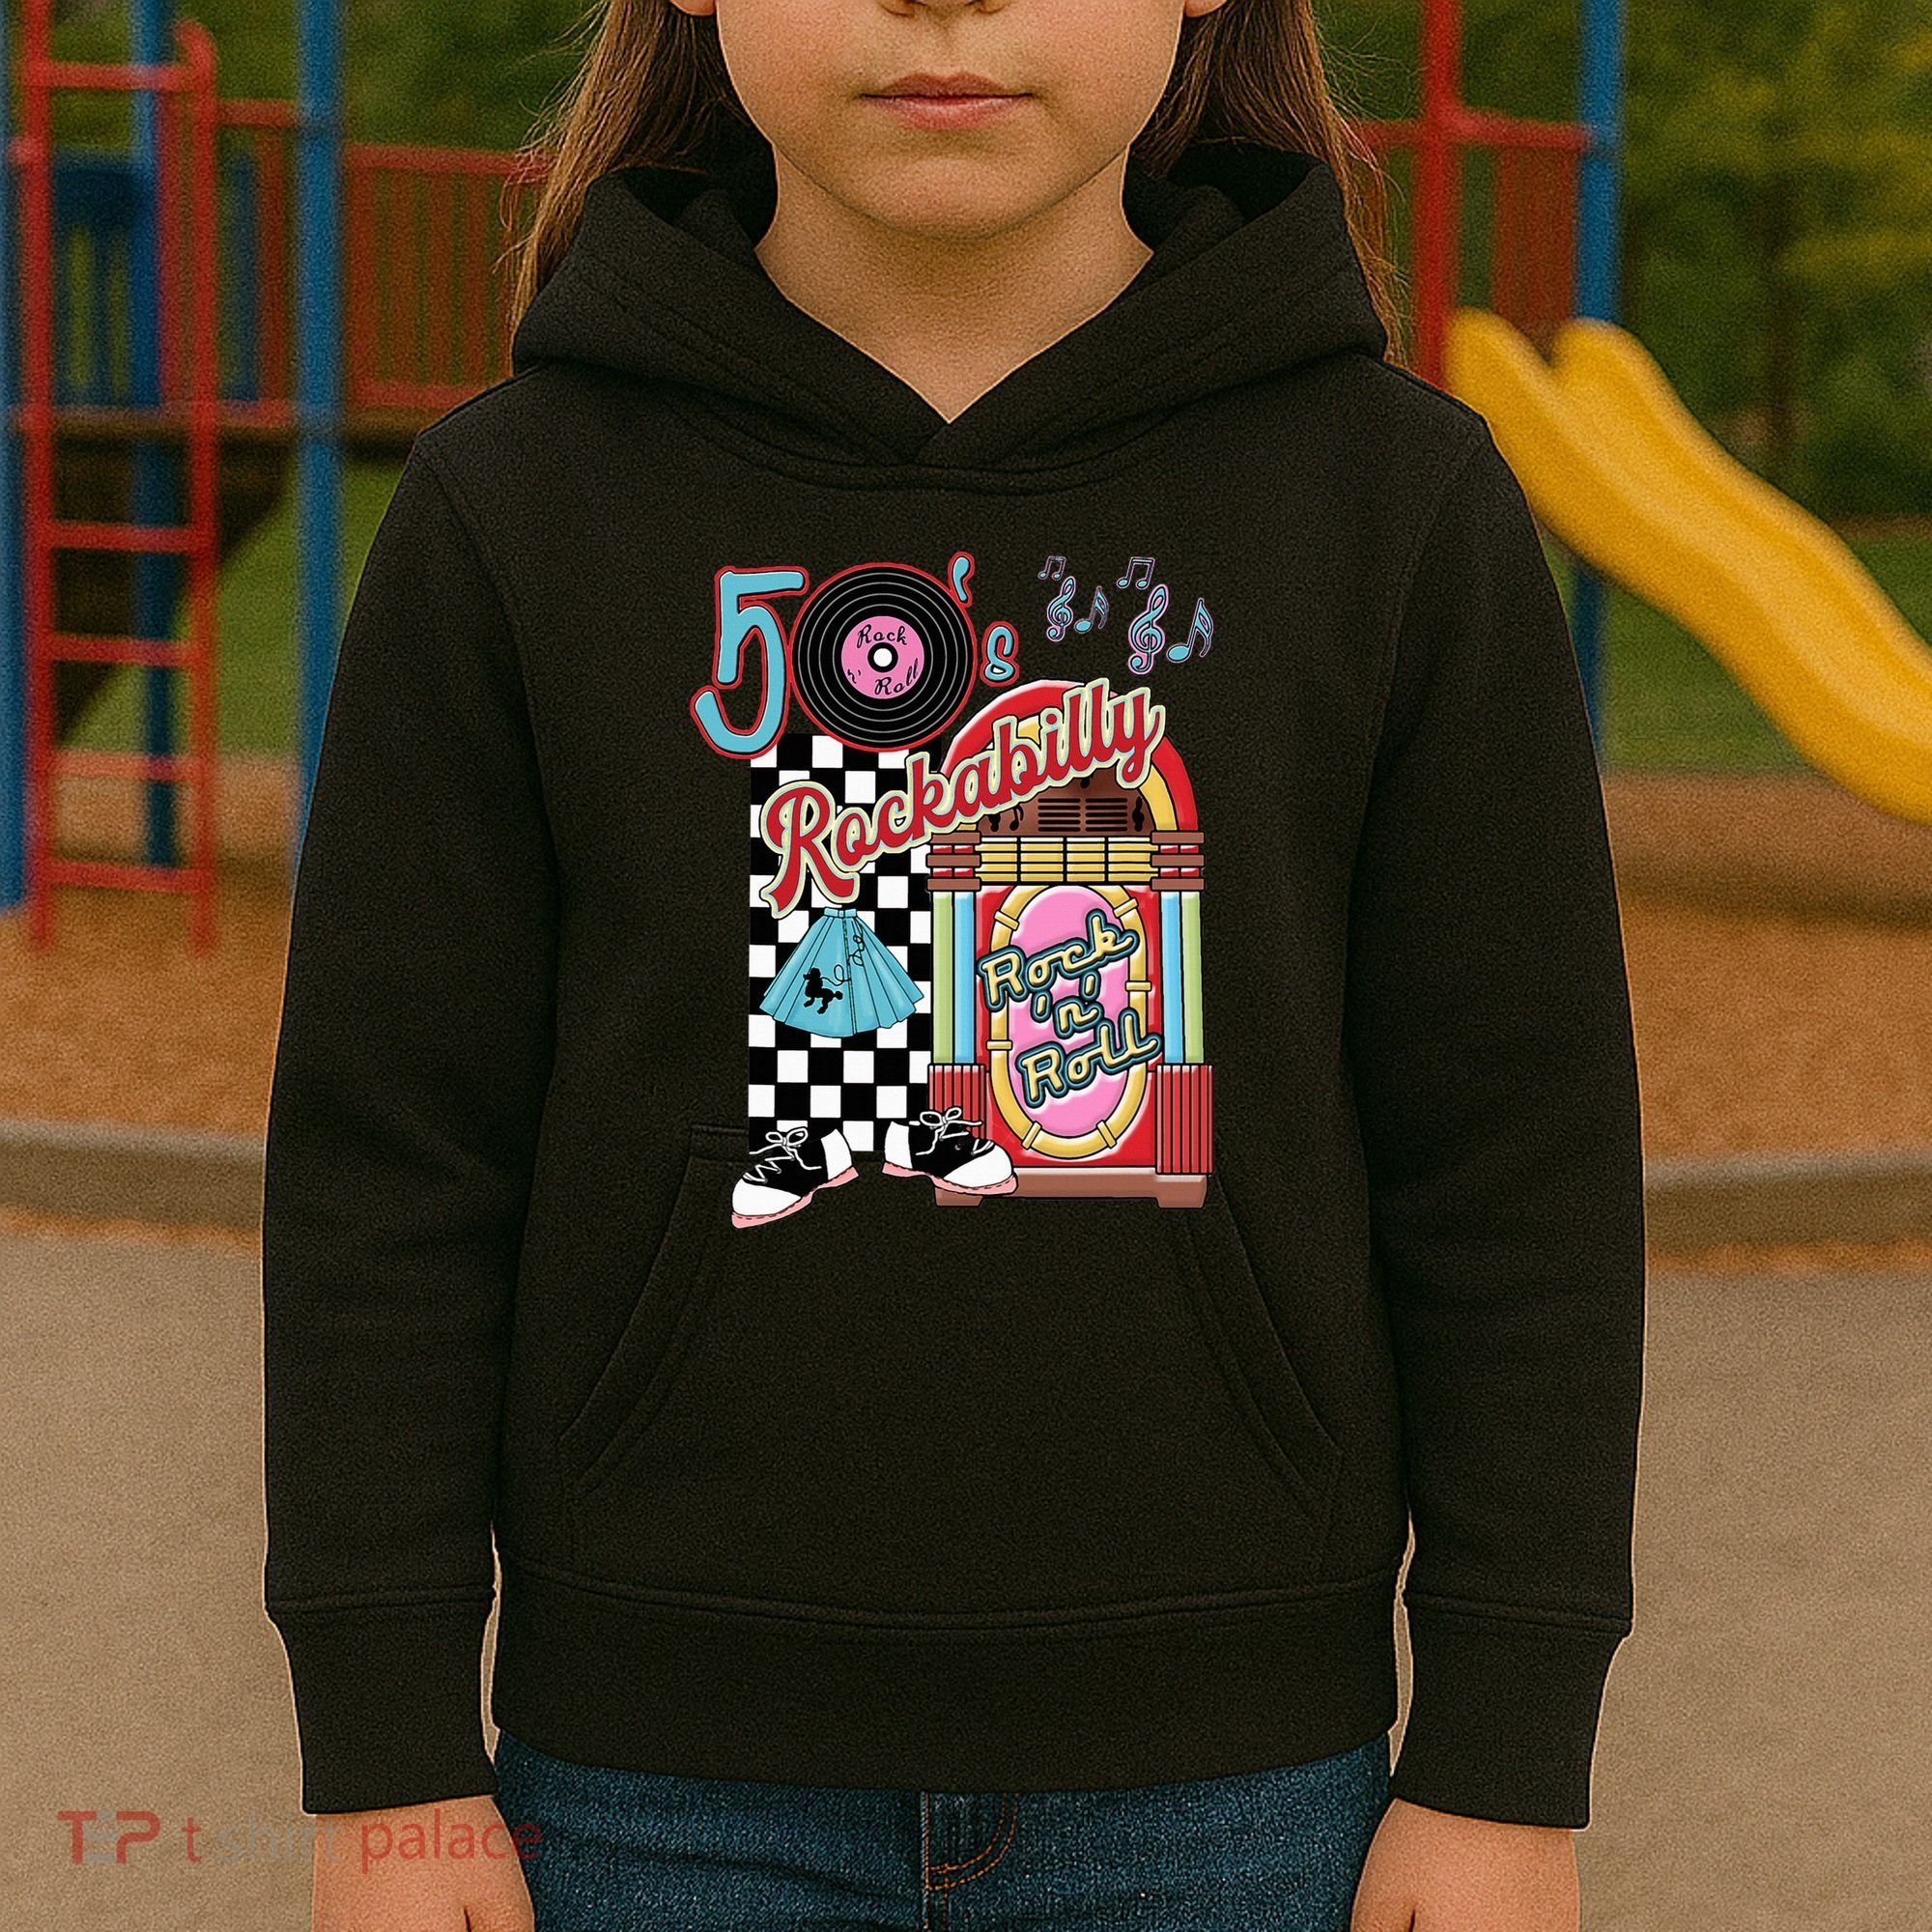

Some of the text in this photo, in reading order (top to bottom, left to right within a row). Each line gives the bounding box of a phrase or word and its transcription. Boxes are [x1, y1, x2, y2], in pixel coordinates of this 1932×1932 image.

[857, 624, 907, 648] Rock
[874, 658, 919, 696] Roll
[760, 679, 1165, 919] Rockabilly
[978, 909, 1139, 1010] Rock
[1016, 1008, 1162, 1107] Roll
